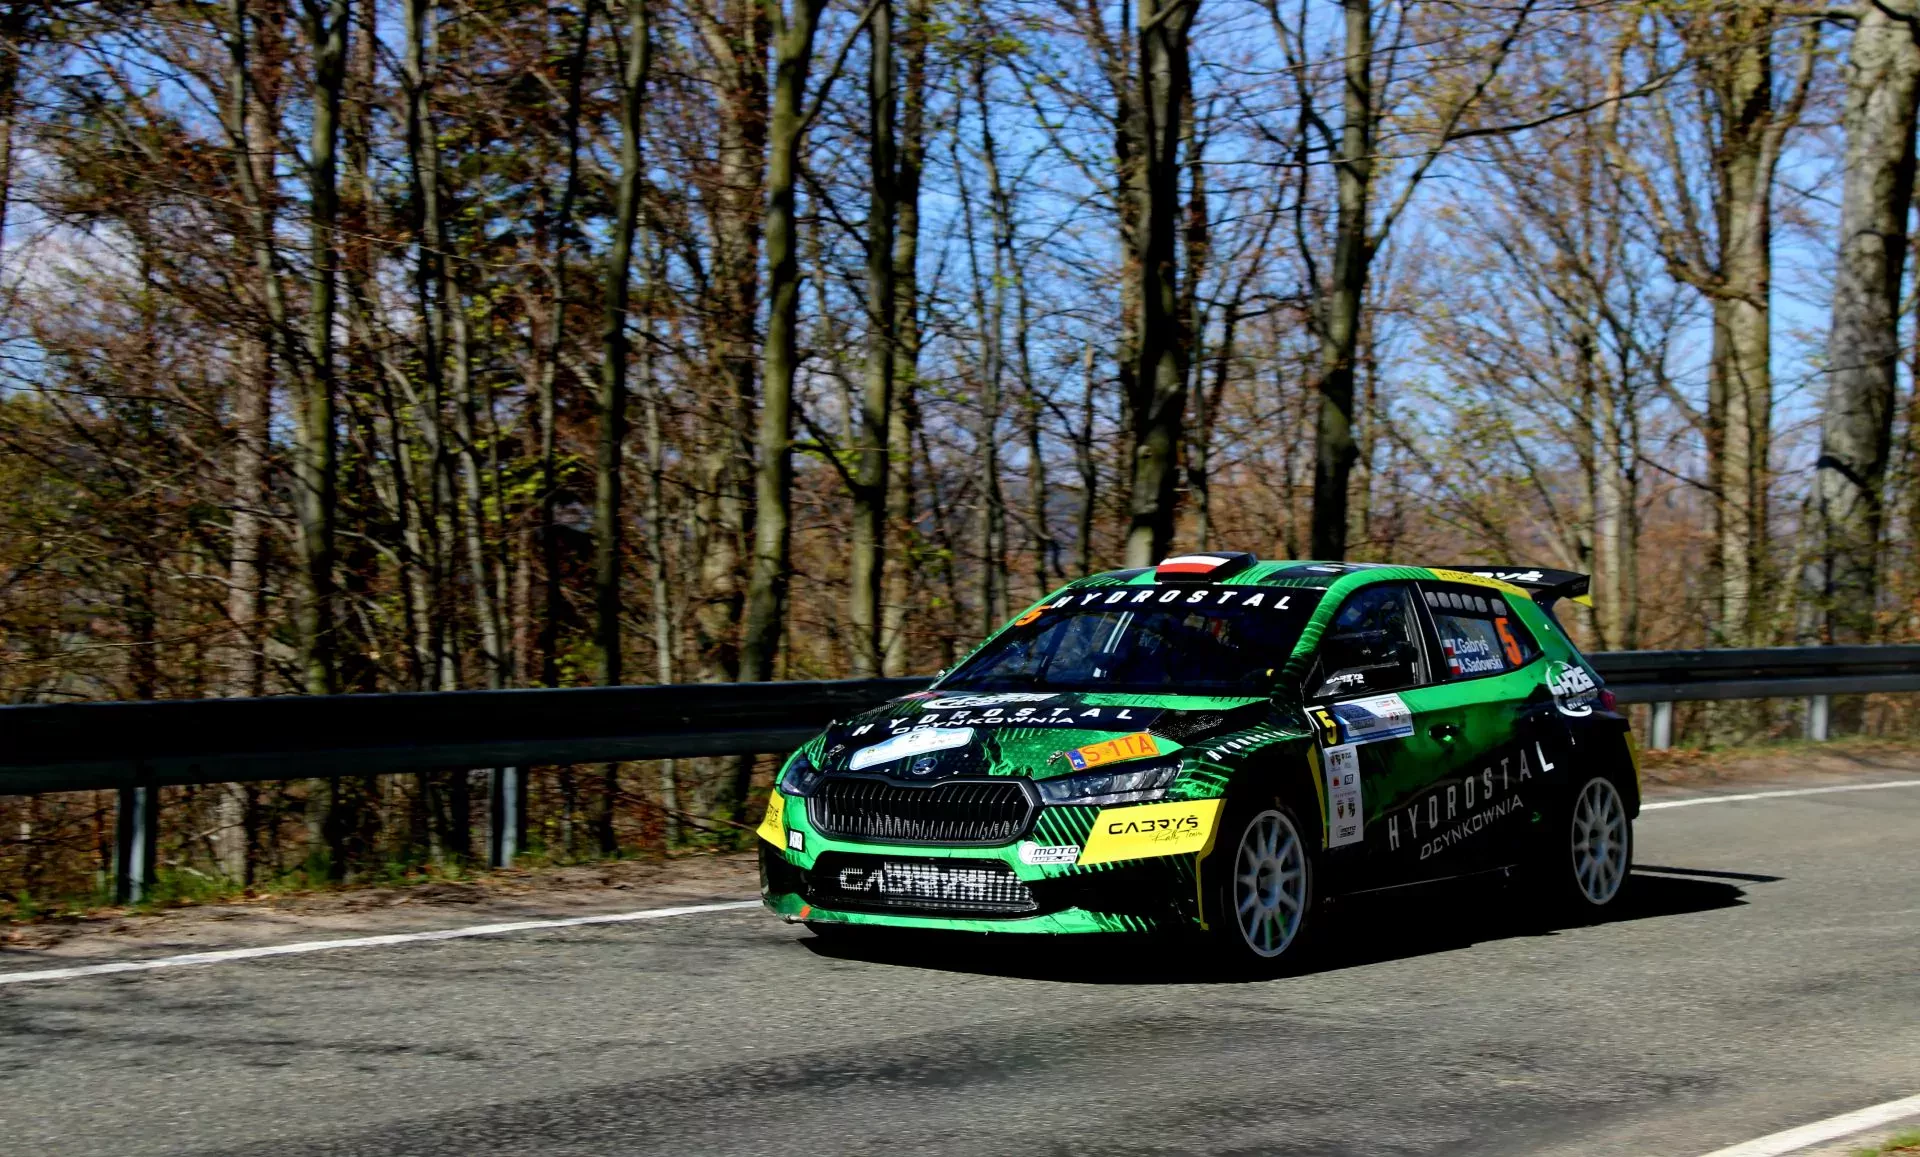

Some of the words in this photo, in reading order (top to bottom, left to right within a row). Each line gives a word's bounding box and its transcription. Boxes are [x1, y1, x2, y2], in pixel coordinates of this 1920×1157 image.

[1050, 589, 1292, 610] HYDROSTAL
[1495, 617, 1523, 668] 5
[1459, 655, 1504, 674] A.Sadowski
[852, 707, 1133, 736] HYDROSTAL
[891, 716, 1074, 735] OCYNKOWNIA
[1316, 710, 1338, 745] 5
[1108, 735, 1155, 757] 1TA
[1074, 758, 1085, 766] PL
[1388, 740, 1555, 852] HYDROSTAL
[1420, 794, 1524, 861] OCYNKOWNIA
[1033, 847, 1078, 856] MOTO
